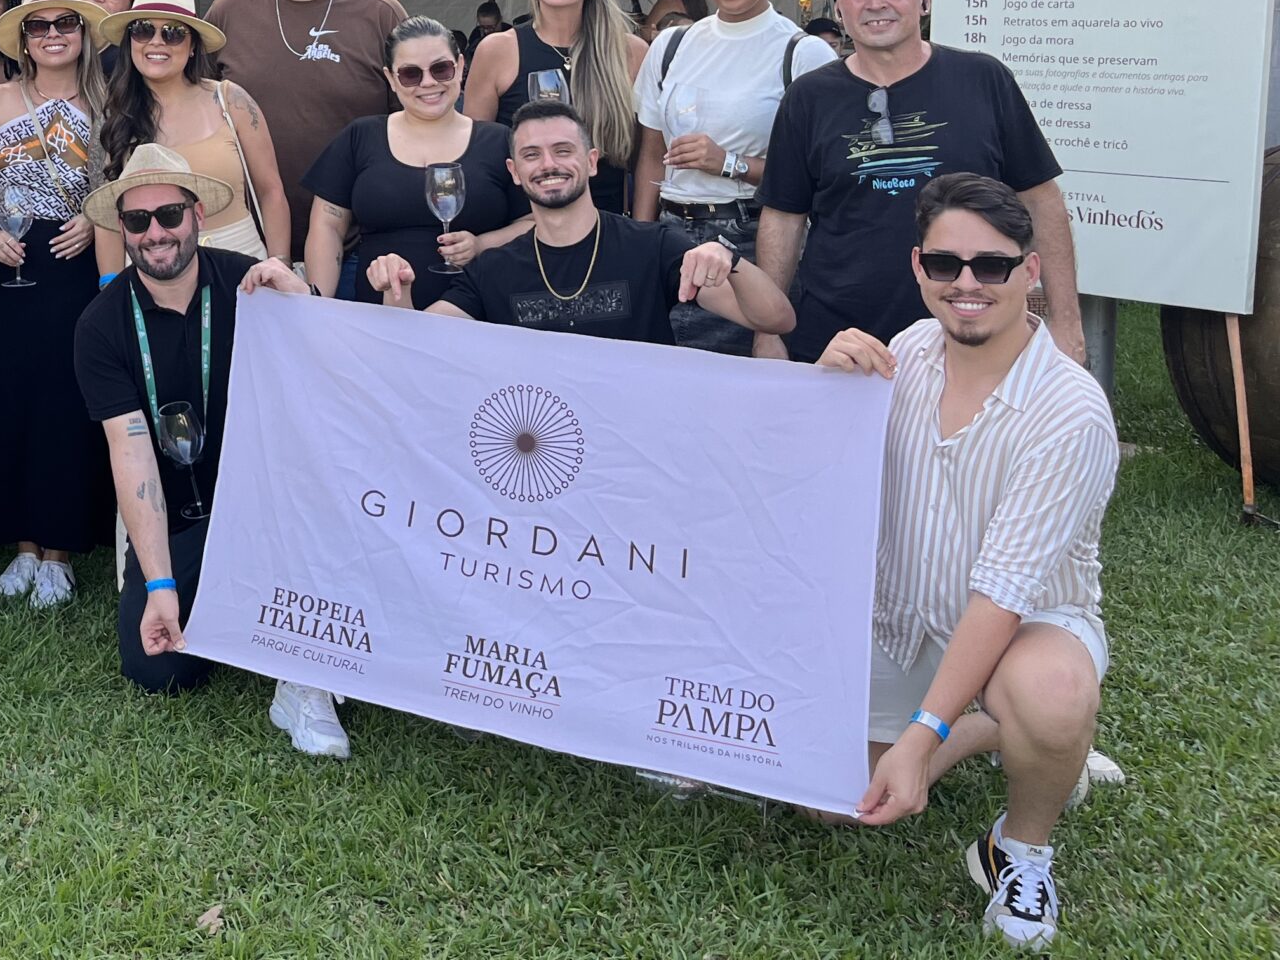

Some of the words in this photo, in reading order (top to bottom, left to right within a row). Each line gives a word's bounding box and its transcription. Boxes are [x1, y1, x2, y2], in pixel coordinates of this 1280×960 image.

[1003, 0, 1028, 10] Jogo
[1030, 0, 1045, 9] de
[1047, 0, 1075, 9] carta
[963, 32, 987, 43] 18h
[1001, 35, 1027, 46] Jogo
[1028, 35, 1043, 45] da
[1045, 37, 1074, 45] mora
[964, 15, 987, 26] 15h
[1003, 17, 1048, 27] Retratos
[1050, 19, 1068, 27] em
[1071, 18, 1120, 30] aquarela
[1123, 20, 1137, 28] ao
[1140, 19, 1164, 28] vivo
[1002, 52, 1056, 63] Memórias
[1058, 55, 1079, 66] que
[1082, 55, 1095, 64] se
[1097, 55, 1158, 67] preservam
[1025, 69, 1043, 77] suas
[1045, 69, 1090, 80] fotografias
[1098, 70, 1151, 80] documentos
[1152, 73, 1185, 83] antigos
[1186, 74, 1209, 84] para
[1039, 99, 1054, 109] de
[1056, 99, 1092, 110] dressa
[1059, 84, 1085, 94] ajude
[1092, 85, 1122, 93] manter
[1132, 86, 1165, 95] história
[1039, 117, 1053, 127] de
[1055, 118, 1091, 129] dressa
[1054, 137, 1091, 148] crochê
[1093, 140, 1100, 148] e
[1103, 139, 1128, 150] tricô
[1062, 191, 1107, 203] ESTIVAL
[360, 490, 688, 579] GIORDANI
[440, 551, 592, 600] TURISMO
[271, 586, 366, 628] EPOPEIA
[257, 604, 373, 653] ITALIANA
[251, 634, 302, 657] PARQUE
[302, 648, 366, 675] CULTURAL
[463, 634, 548, 671] MARIA
[443, 652, 562, 699] FUMAÇA
[443, 685, 480, 704] TREM
[482, 695, 504, 709] DO
[509, 701, 554, 720] VINHO
[664, 676, 734, 707] TREM
[738, 689, 775, 713] DO
[655, 698, 777, 748] PAMPA
[646, 734, 668, 745] NOS
[670, 739, 715, 755] TRILHOS
[717, 748, 731, 758] DA
[733, 753, 783, 768] HISTÓRIA
